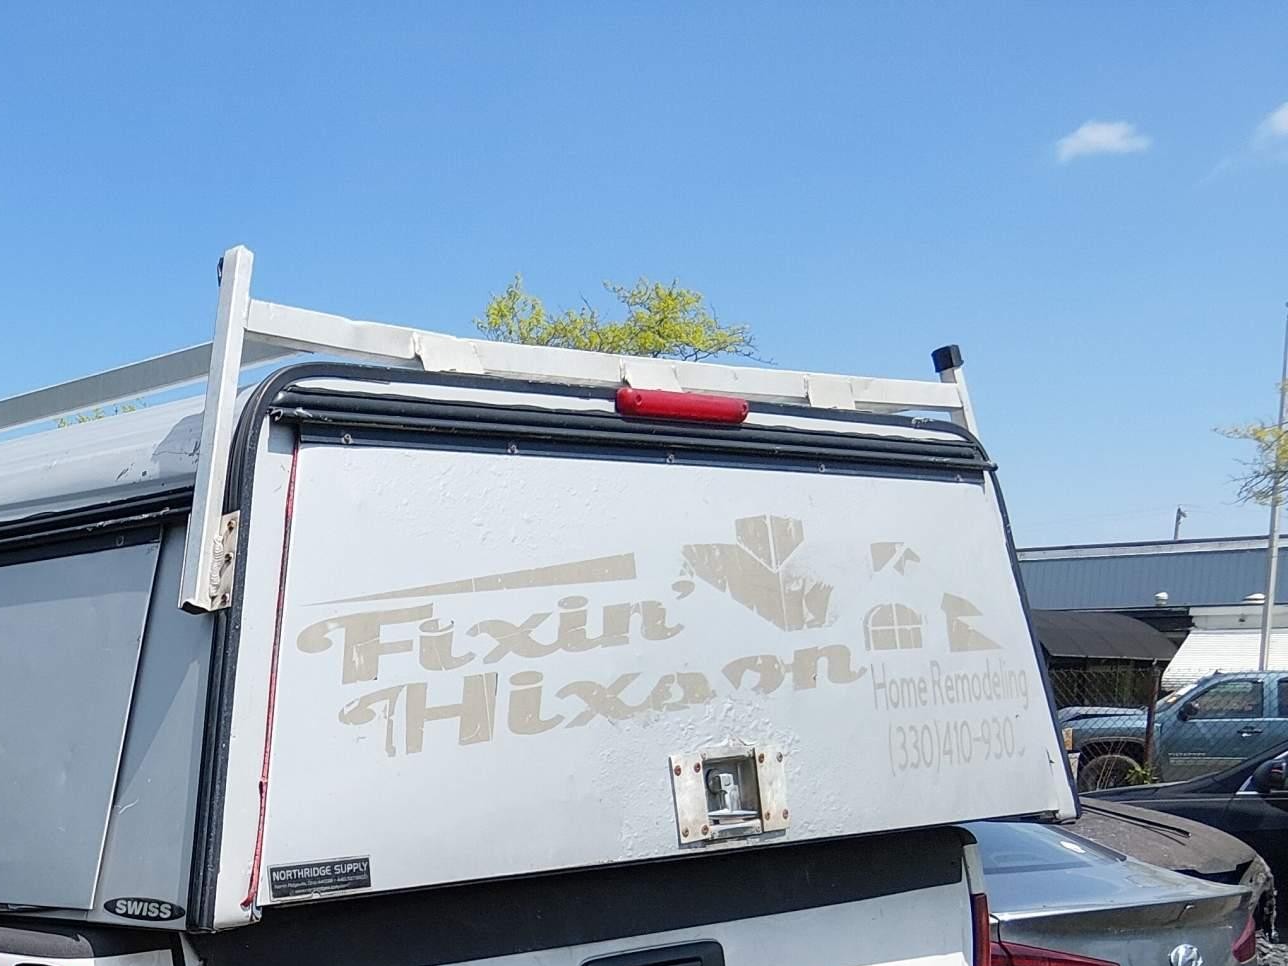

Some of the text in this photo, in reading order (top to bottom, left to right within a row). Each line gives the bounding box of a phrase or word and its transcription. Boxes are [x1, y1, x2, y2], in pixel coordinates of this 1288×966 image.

[297, 580, 695, 684] Fixin'
[871, 656, 1029, 711] Home Remodeling
[888, 715, 1026, 777] (330)410-930
[272, 866, 332, 882] NORTHRIDGE
[334, 861, 369, 875] SUPPLY
[114, 899, 172, 919] SWISS
